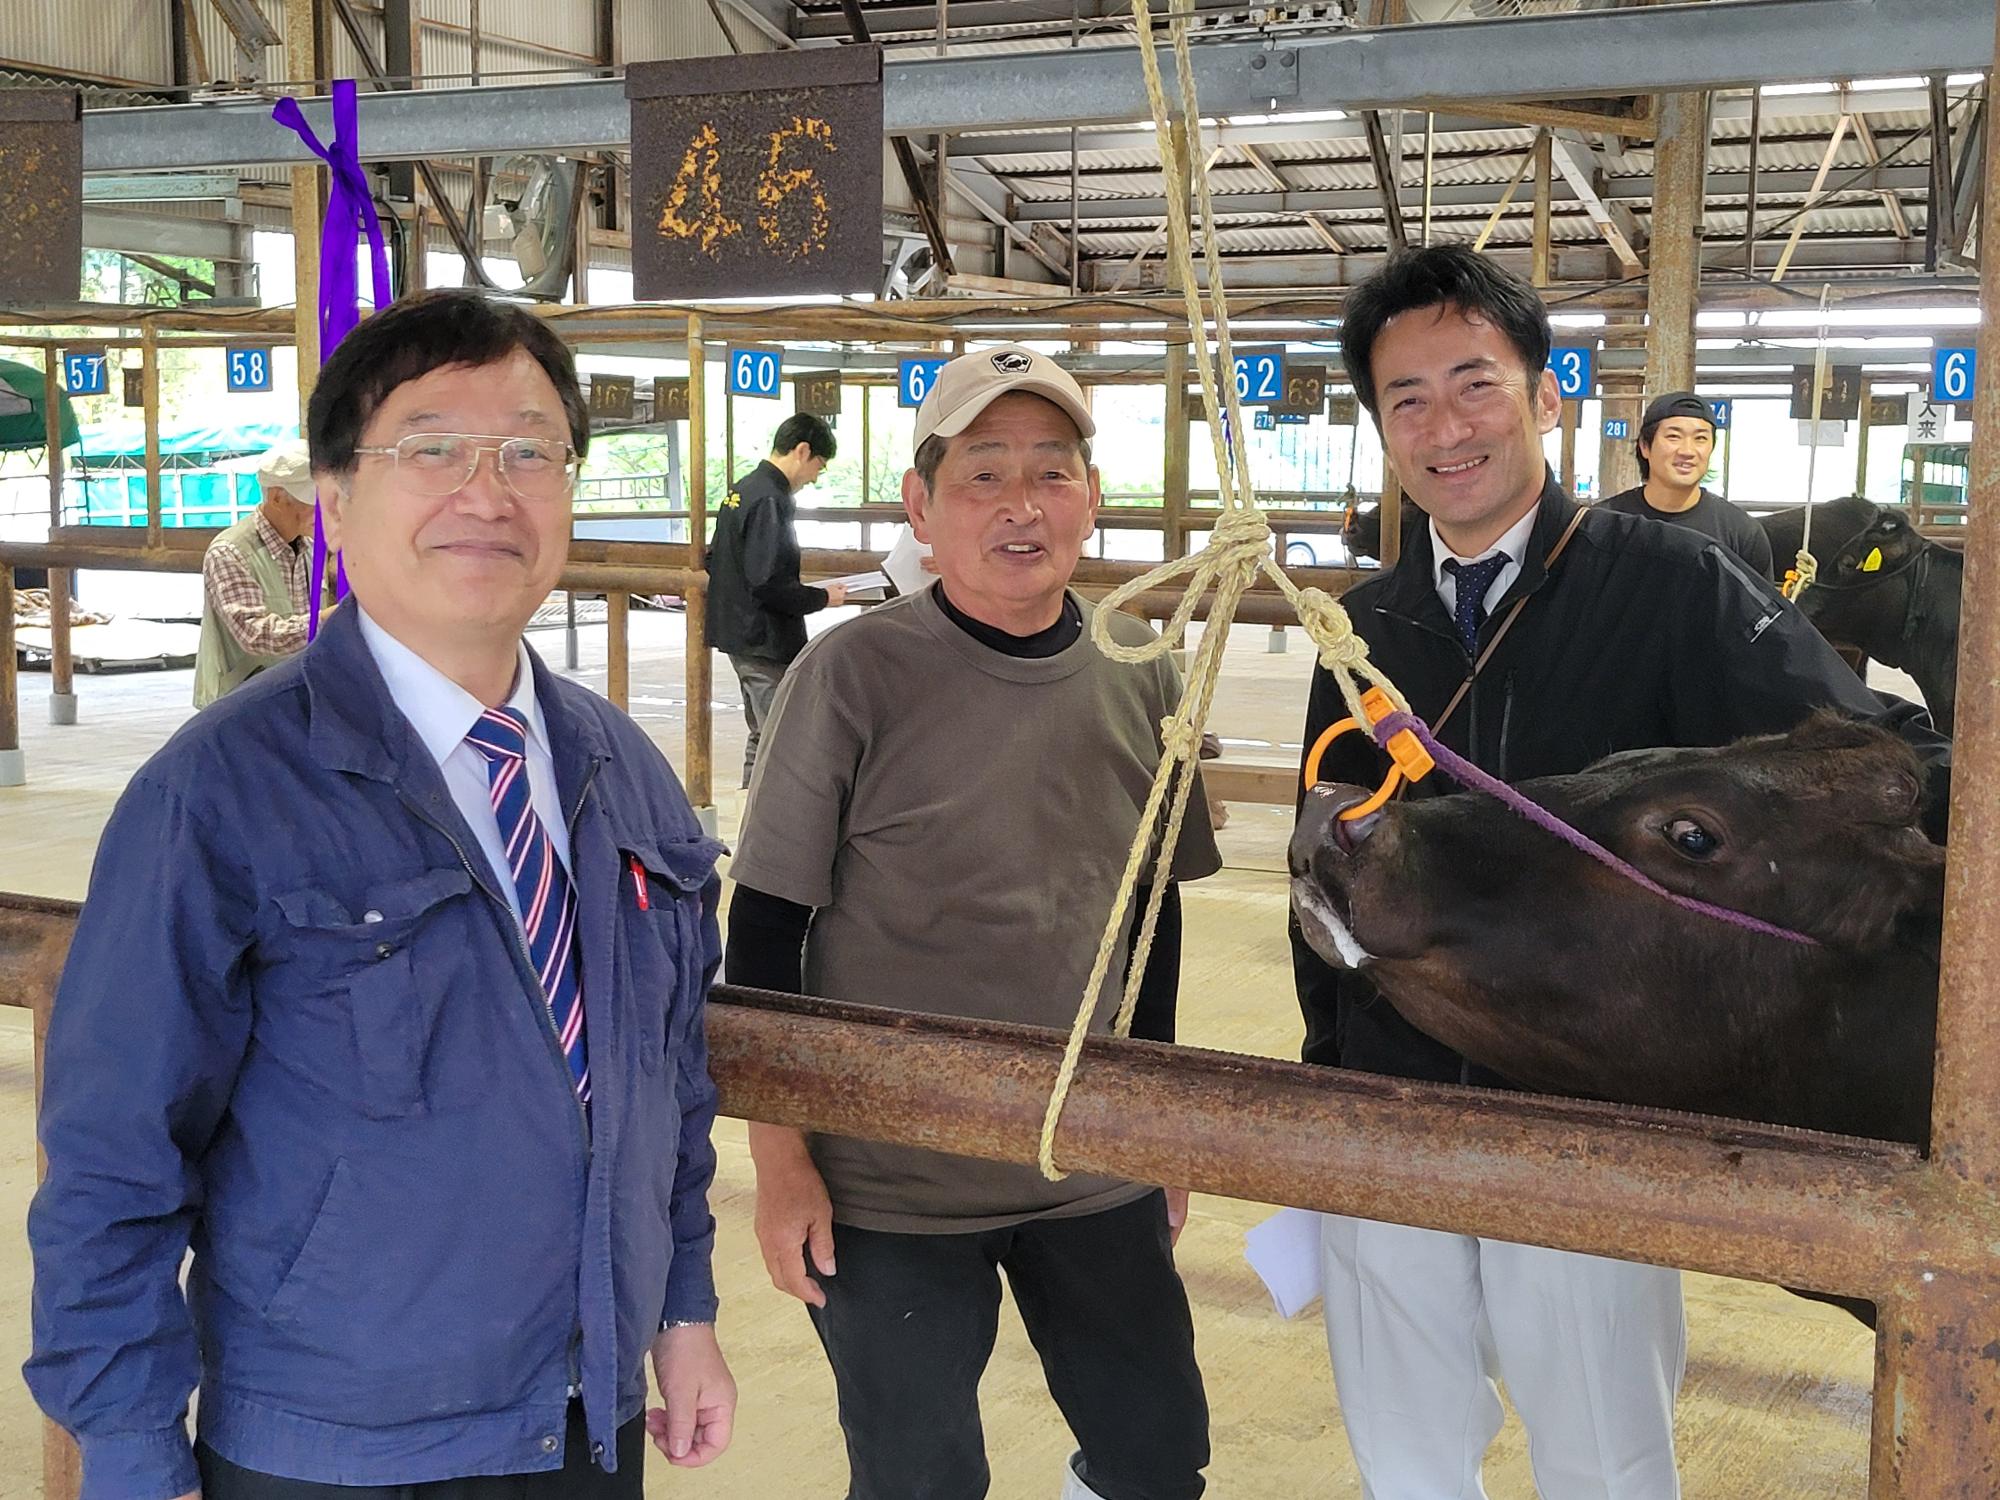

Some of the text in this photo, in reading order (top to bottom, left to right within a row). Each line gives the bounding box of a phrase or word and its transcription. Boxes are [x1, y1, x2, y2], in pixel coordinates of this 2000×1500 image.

[657, 116, 837, 262] 46
[70, 358, 100, 390] 57
[232, 352, 264, 385] 58
[737, 353, 775, 391] 60
[1233, 358, 1276, 398] 62
[1255, 414, 1275, 429] 279
[1606, 421, 1627, 437] 281
